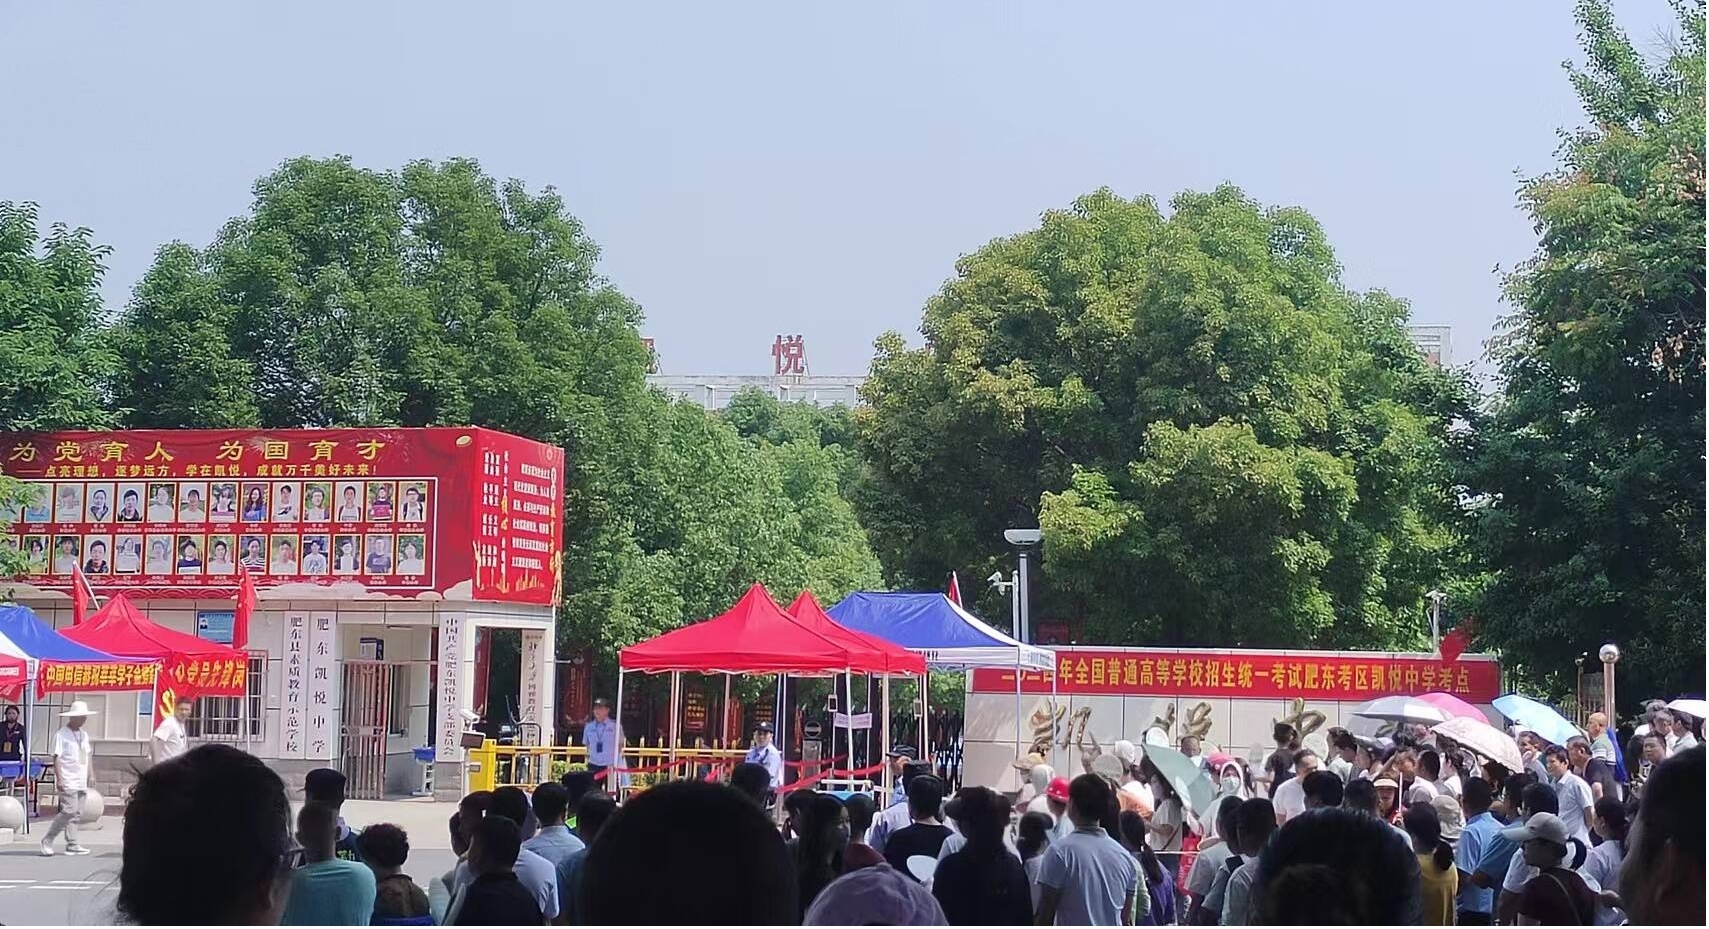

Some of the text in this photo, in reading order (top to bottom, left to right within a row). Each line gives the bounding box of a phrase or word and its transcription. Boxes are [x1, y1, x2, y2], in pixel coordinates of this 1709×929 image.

[771, 334, 805, 375] 悦
[9, 439, 385, 462] 为党育人 为国育才
[286, 616, 303, 752] 肥东县素质教育示范学校
[311, 617, 330, 753] 肥东凯悦中学
[1001, 657, 1471, 693] 年全国普通高等学校招生统一考试肥东考区凯悦中学考点
